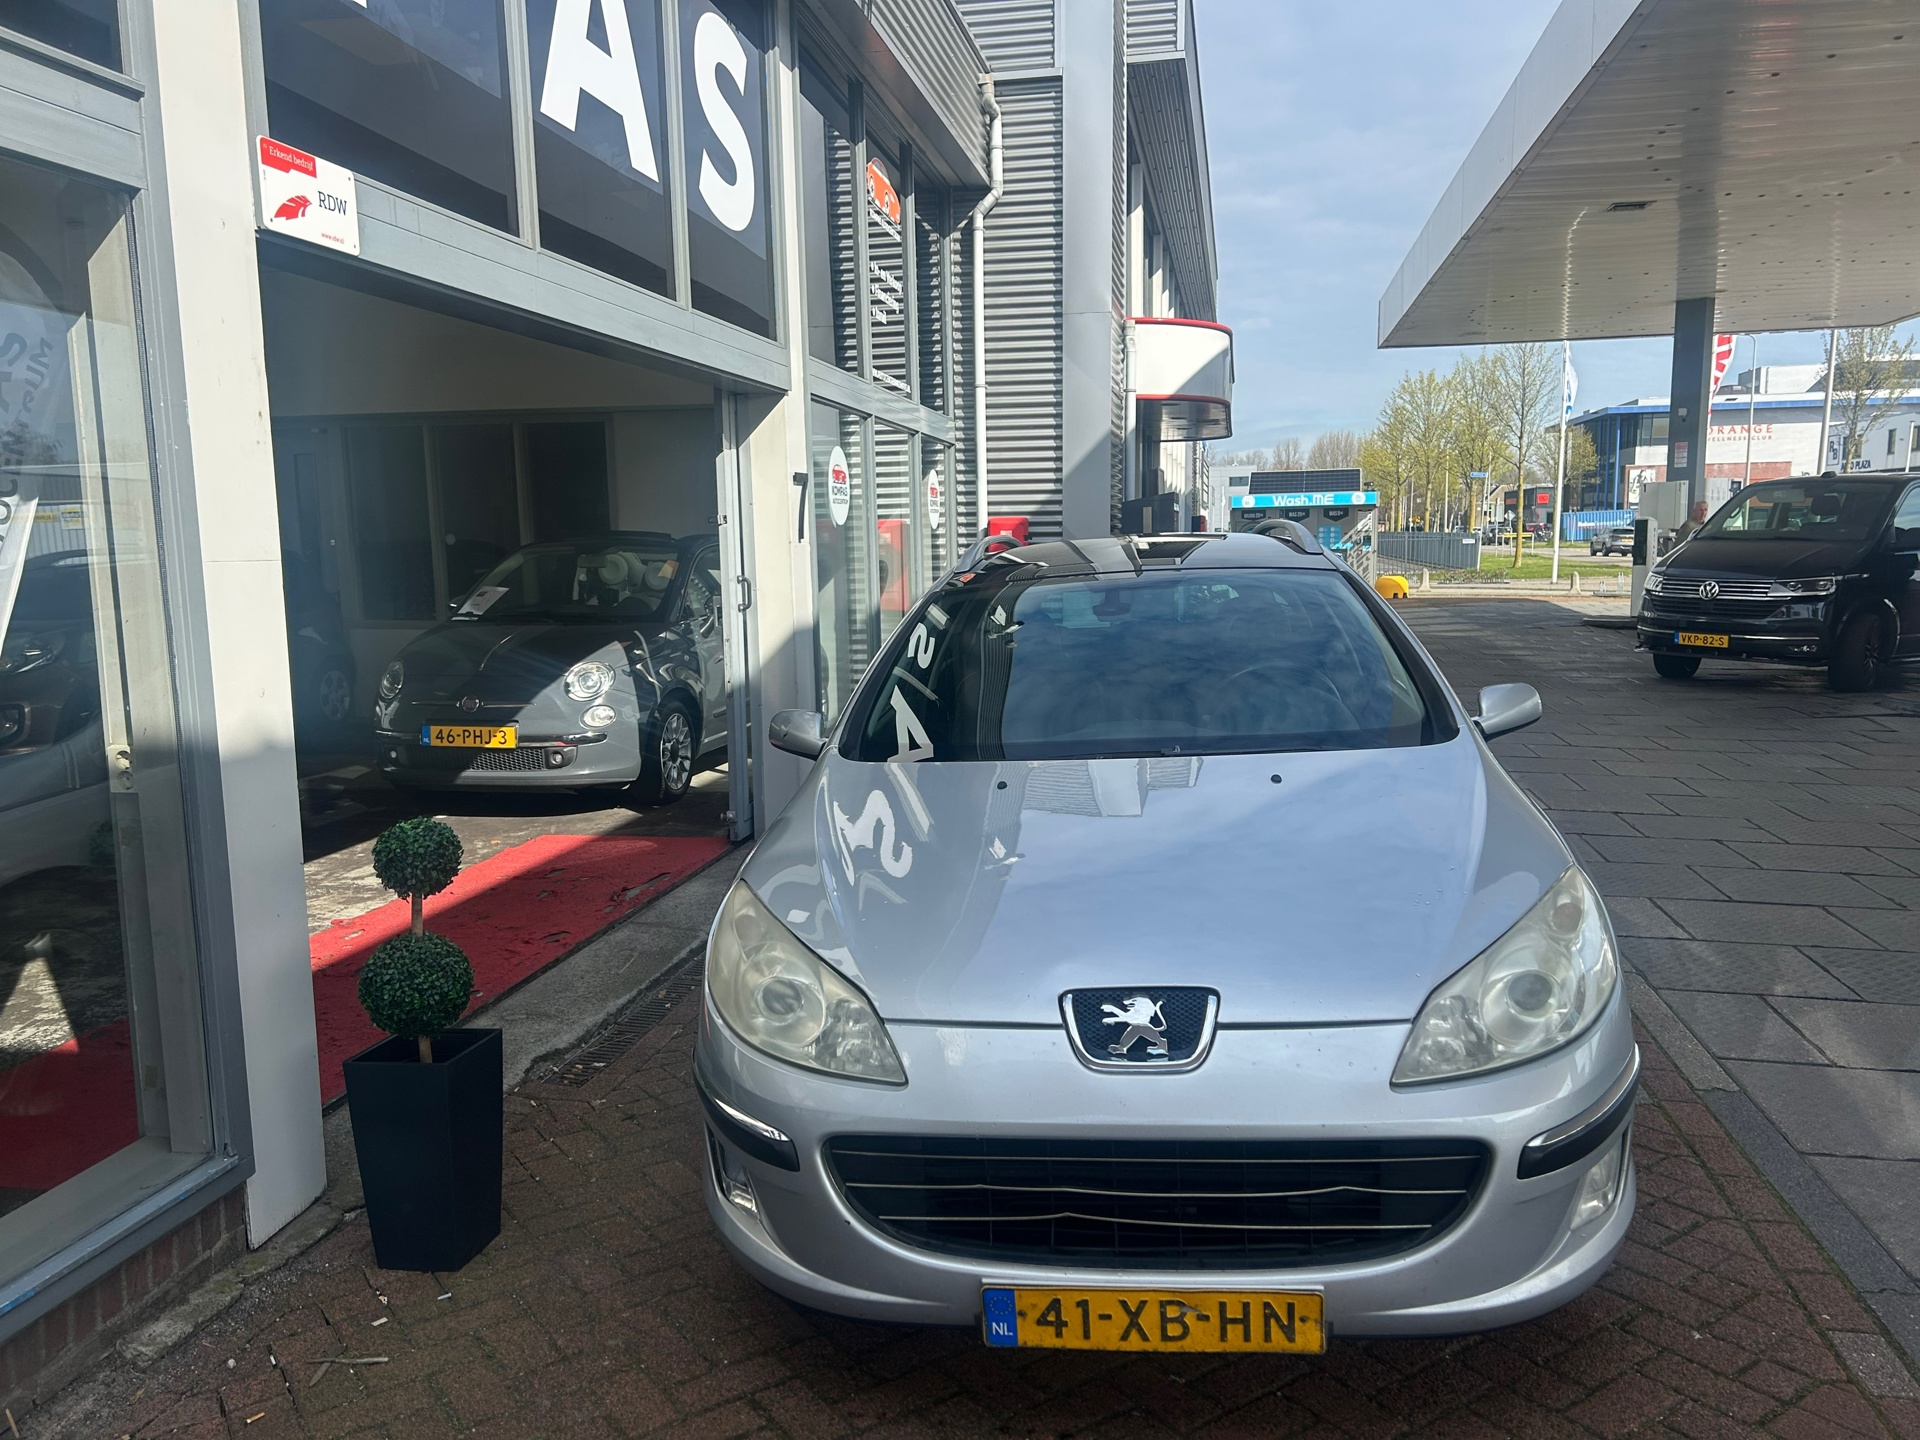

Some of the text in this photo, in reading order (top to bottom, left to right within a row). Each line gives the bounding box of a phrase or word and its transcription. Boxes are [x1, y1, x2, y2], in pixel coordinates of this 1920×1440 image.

[269, 146, 314, 172] Erkend bedrijf
[318, 190, 347, 216] RDW
[1840, 460, 1872, 471] AO PLAZA
[1681, 634, 1724, 646] VKP-82-S
[435, 729, 507, 745] 46-PHJ-3
[992, 1297, 1297, 1343] NL 41-XB-HN
